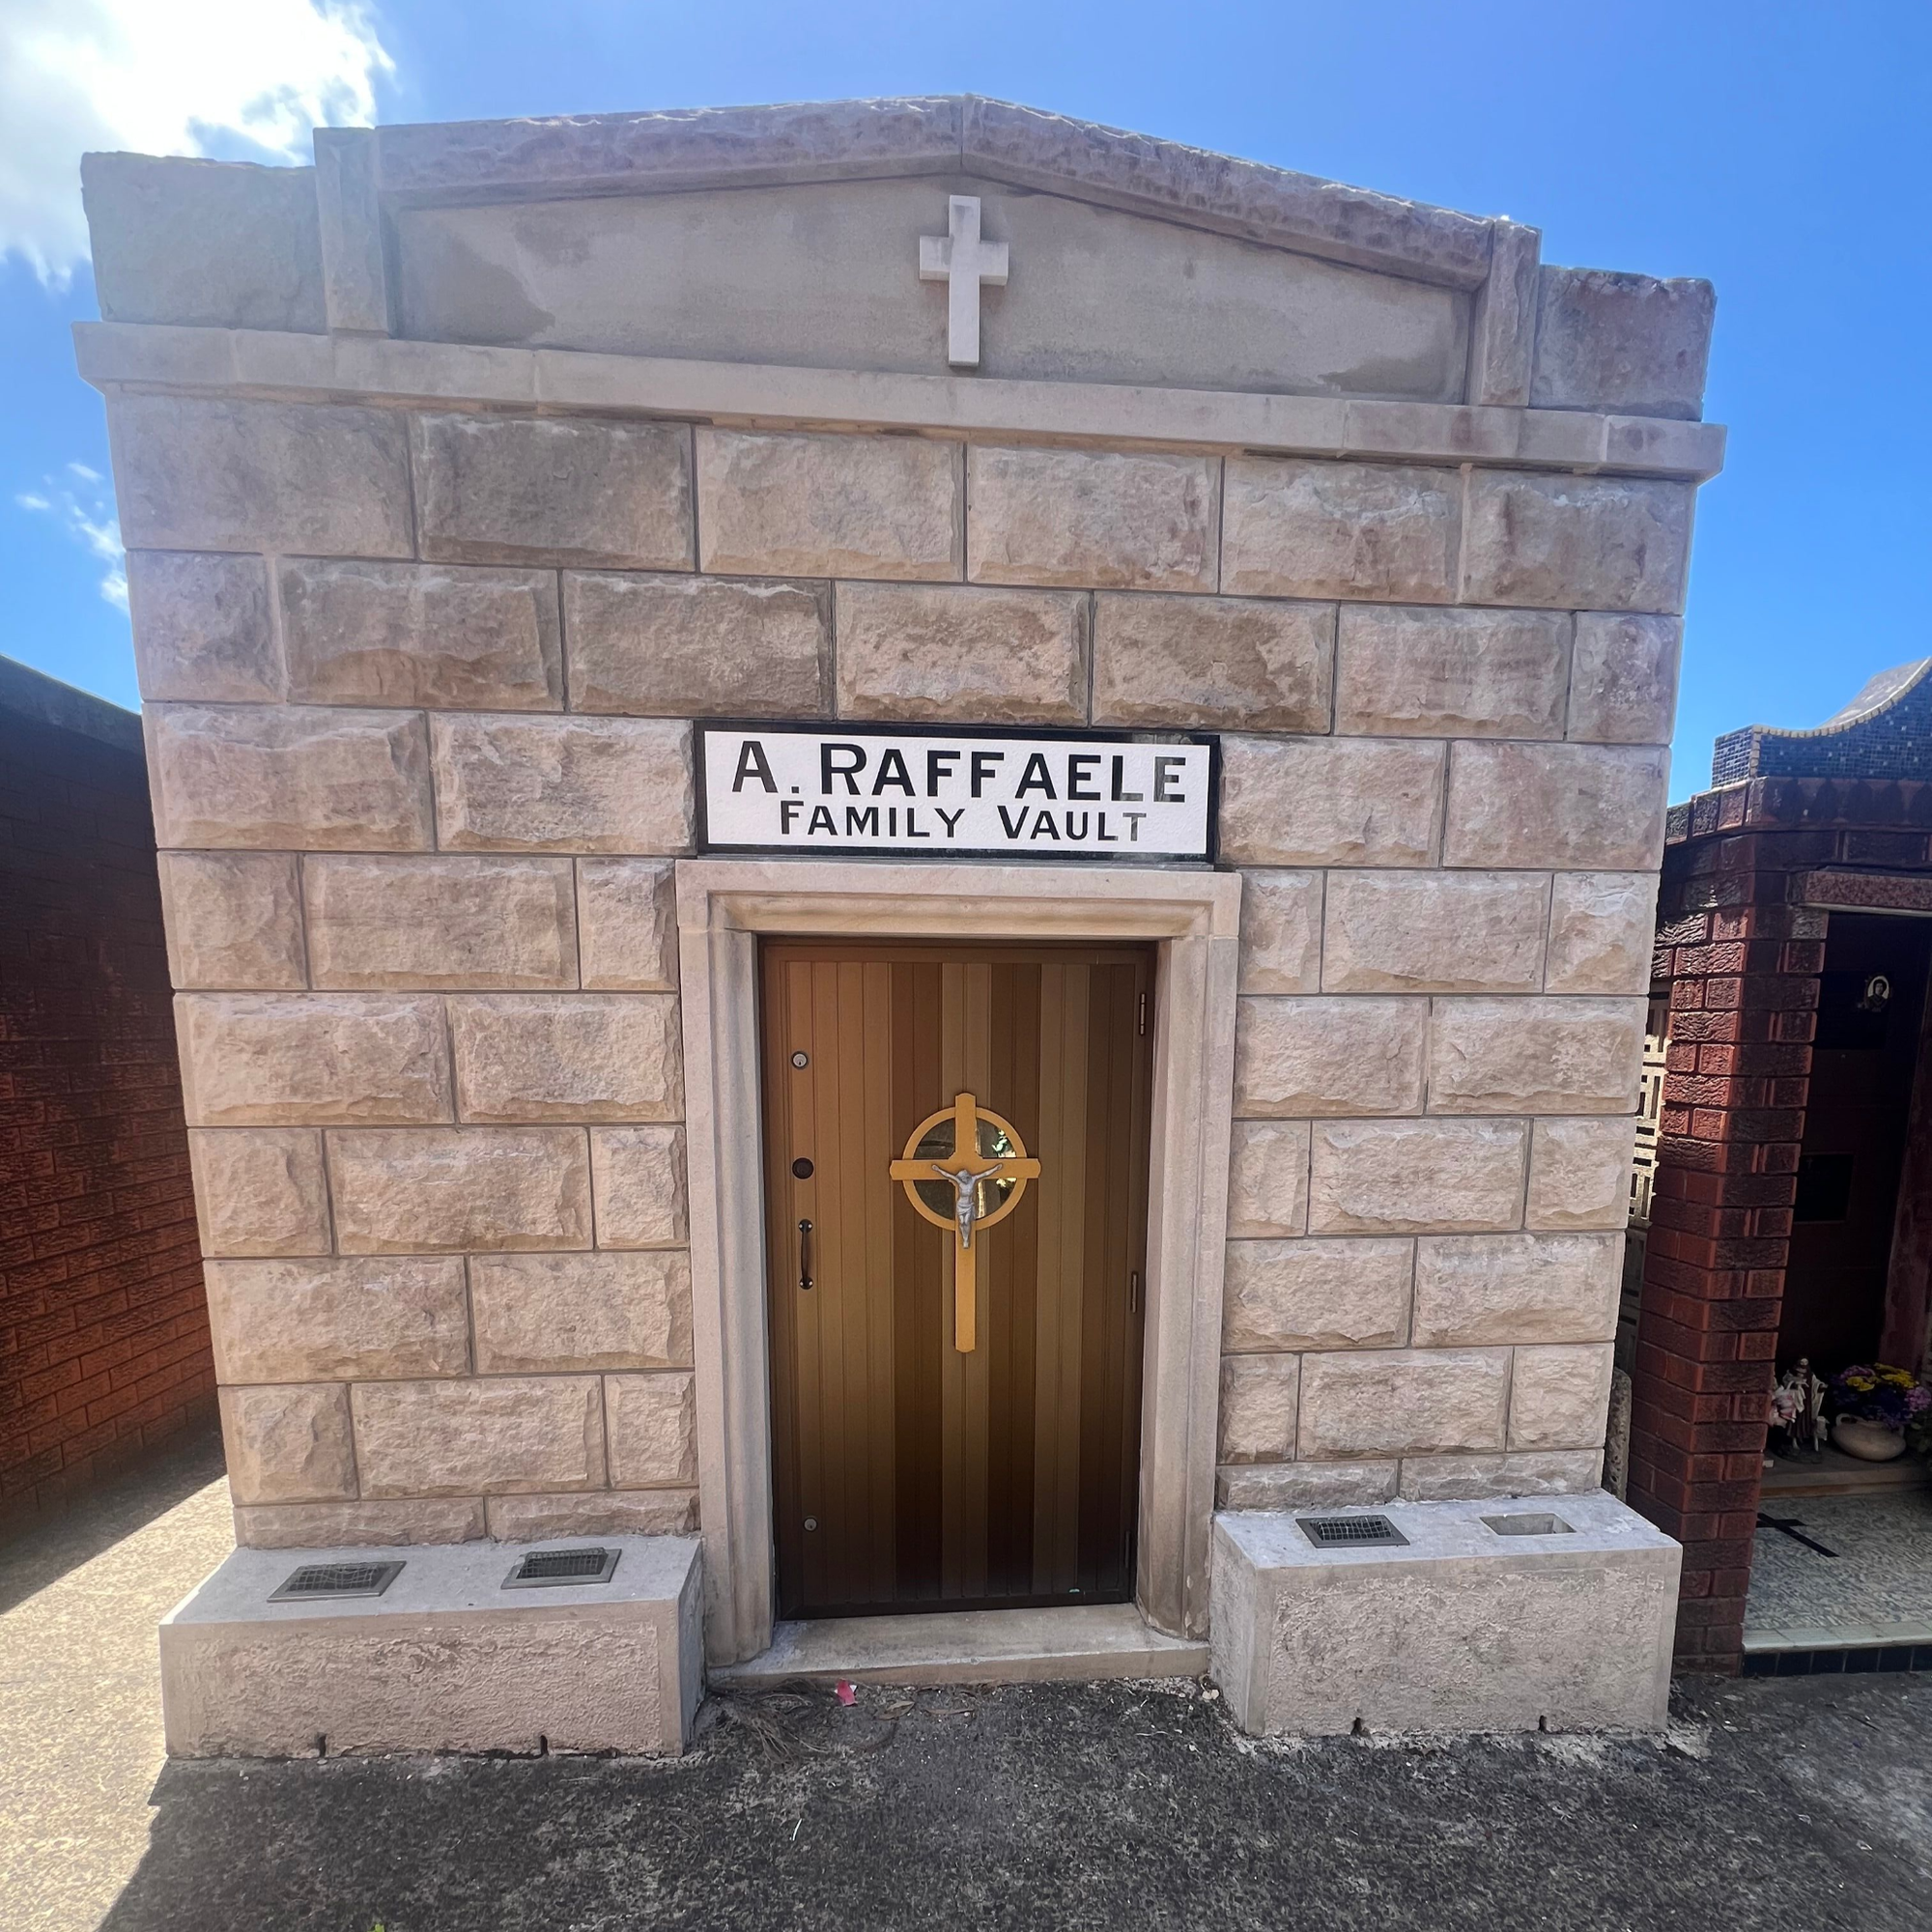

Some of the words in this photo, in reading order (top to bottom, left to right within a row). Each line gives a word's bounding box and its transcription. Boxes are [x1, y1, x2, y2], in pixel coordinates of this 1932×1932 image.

[731, 740, 800, 795] A.
[820, 743, 1186, 803] RAFFAELE
[780, 800, 966, 838] FAMILY
[997, 805, 1148, 842] VAULT
